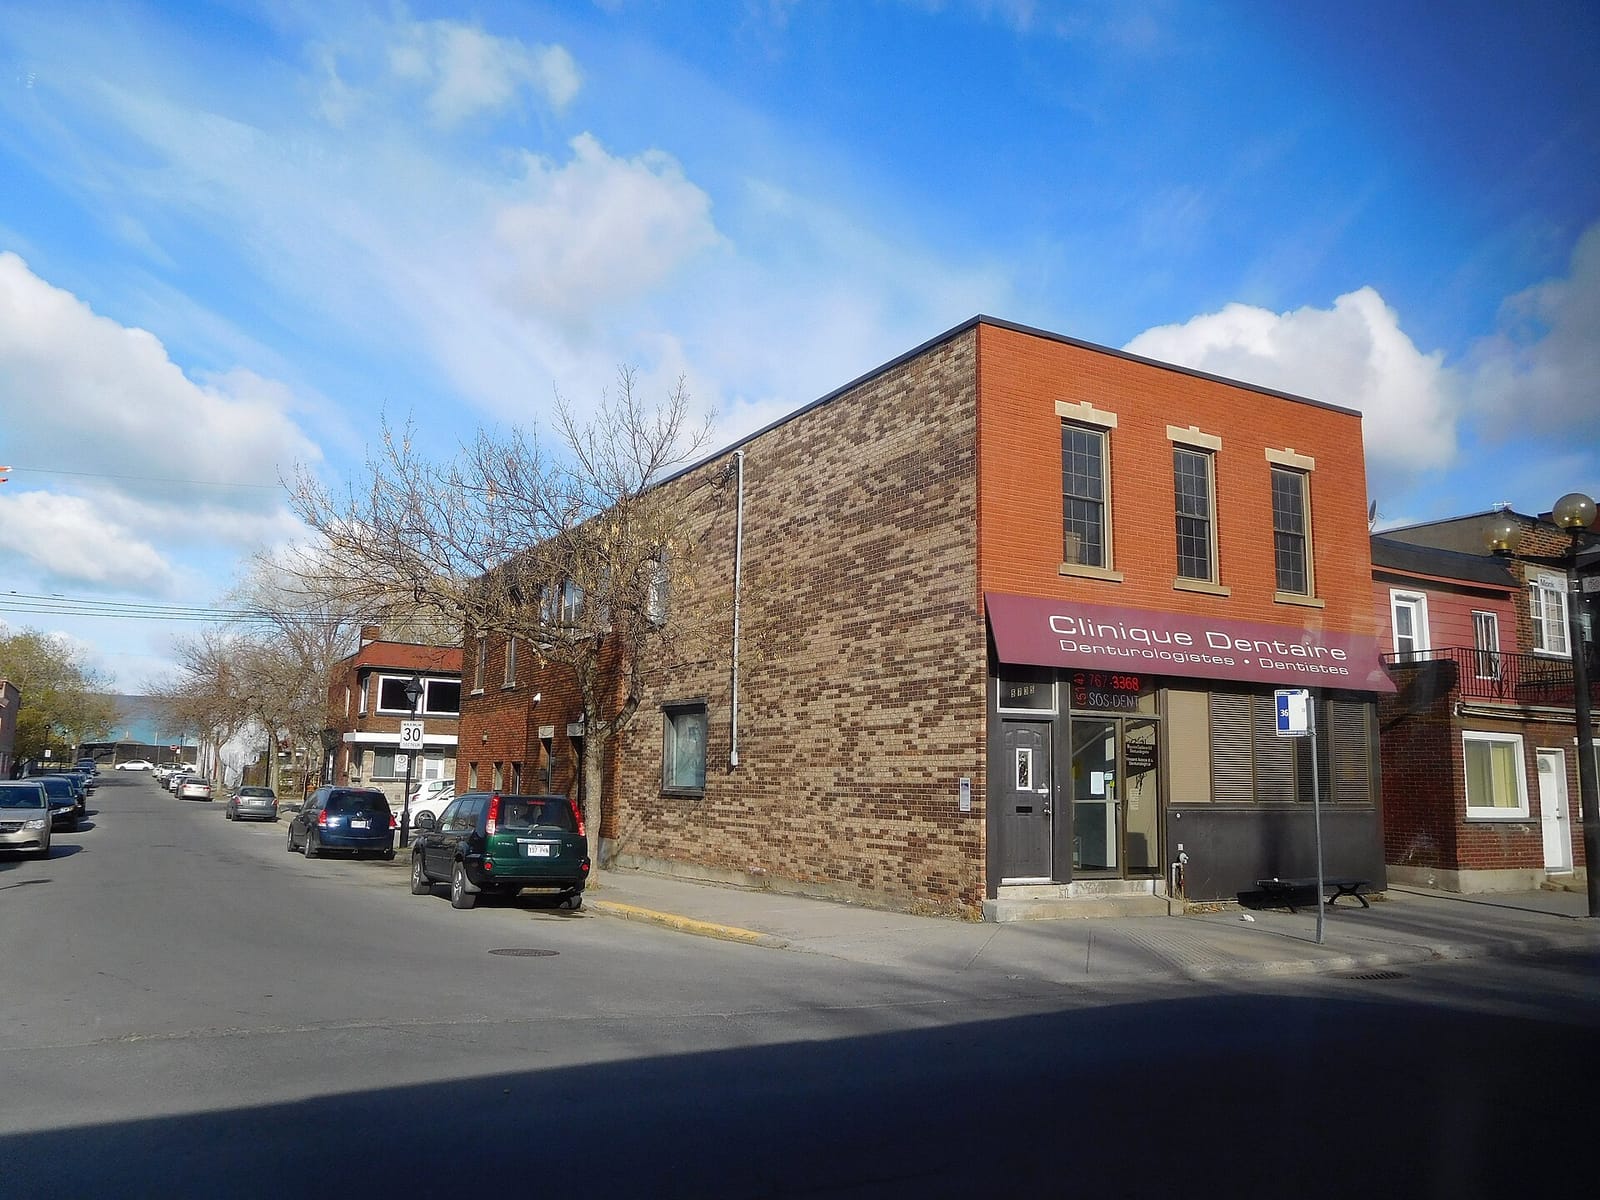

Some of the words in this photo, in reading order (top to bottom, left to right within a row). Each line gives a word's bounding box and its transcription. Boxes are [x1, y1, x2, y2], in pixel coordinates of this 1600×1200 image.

[1049, 614, 1193, 646] Clinique
[1205, 631, 1347, 661] Dentaire
[1059, 639, 1235, 664] Denturologistes
[1258, 657, 1349, 676] Dentistes
[403, 727, 421, 742] 30
